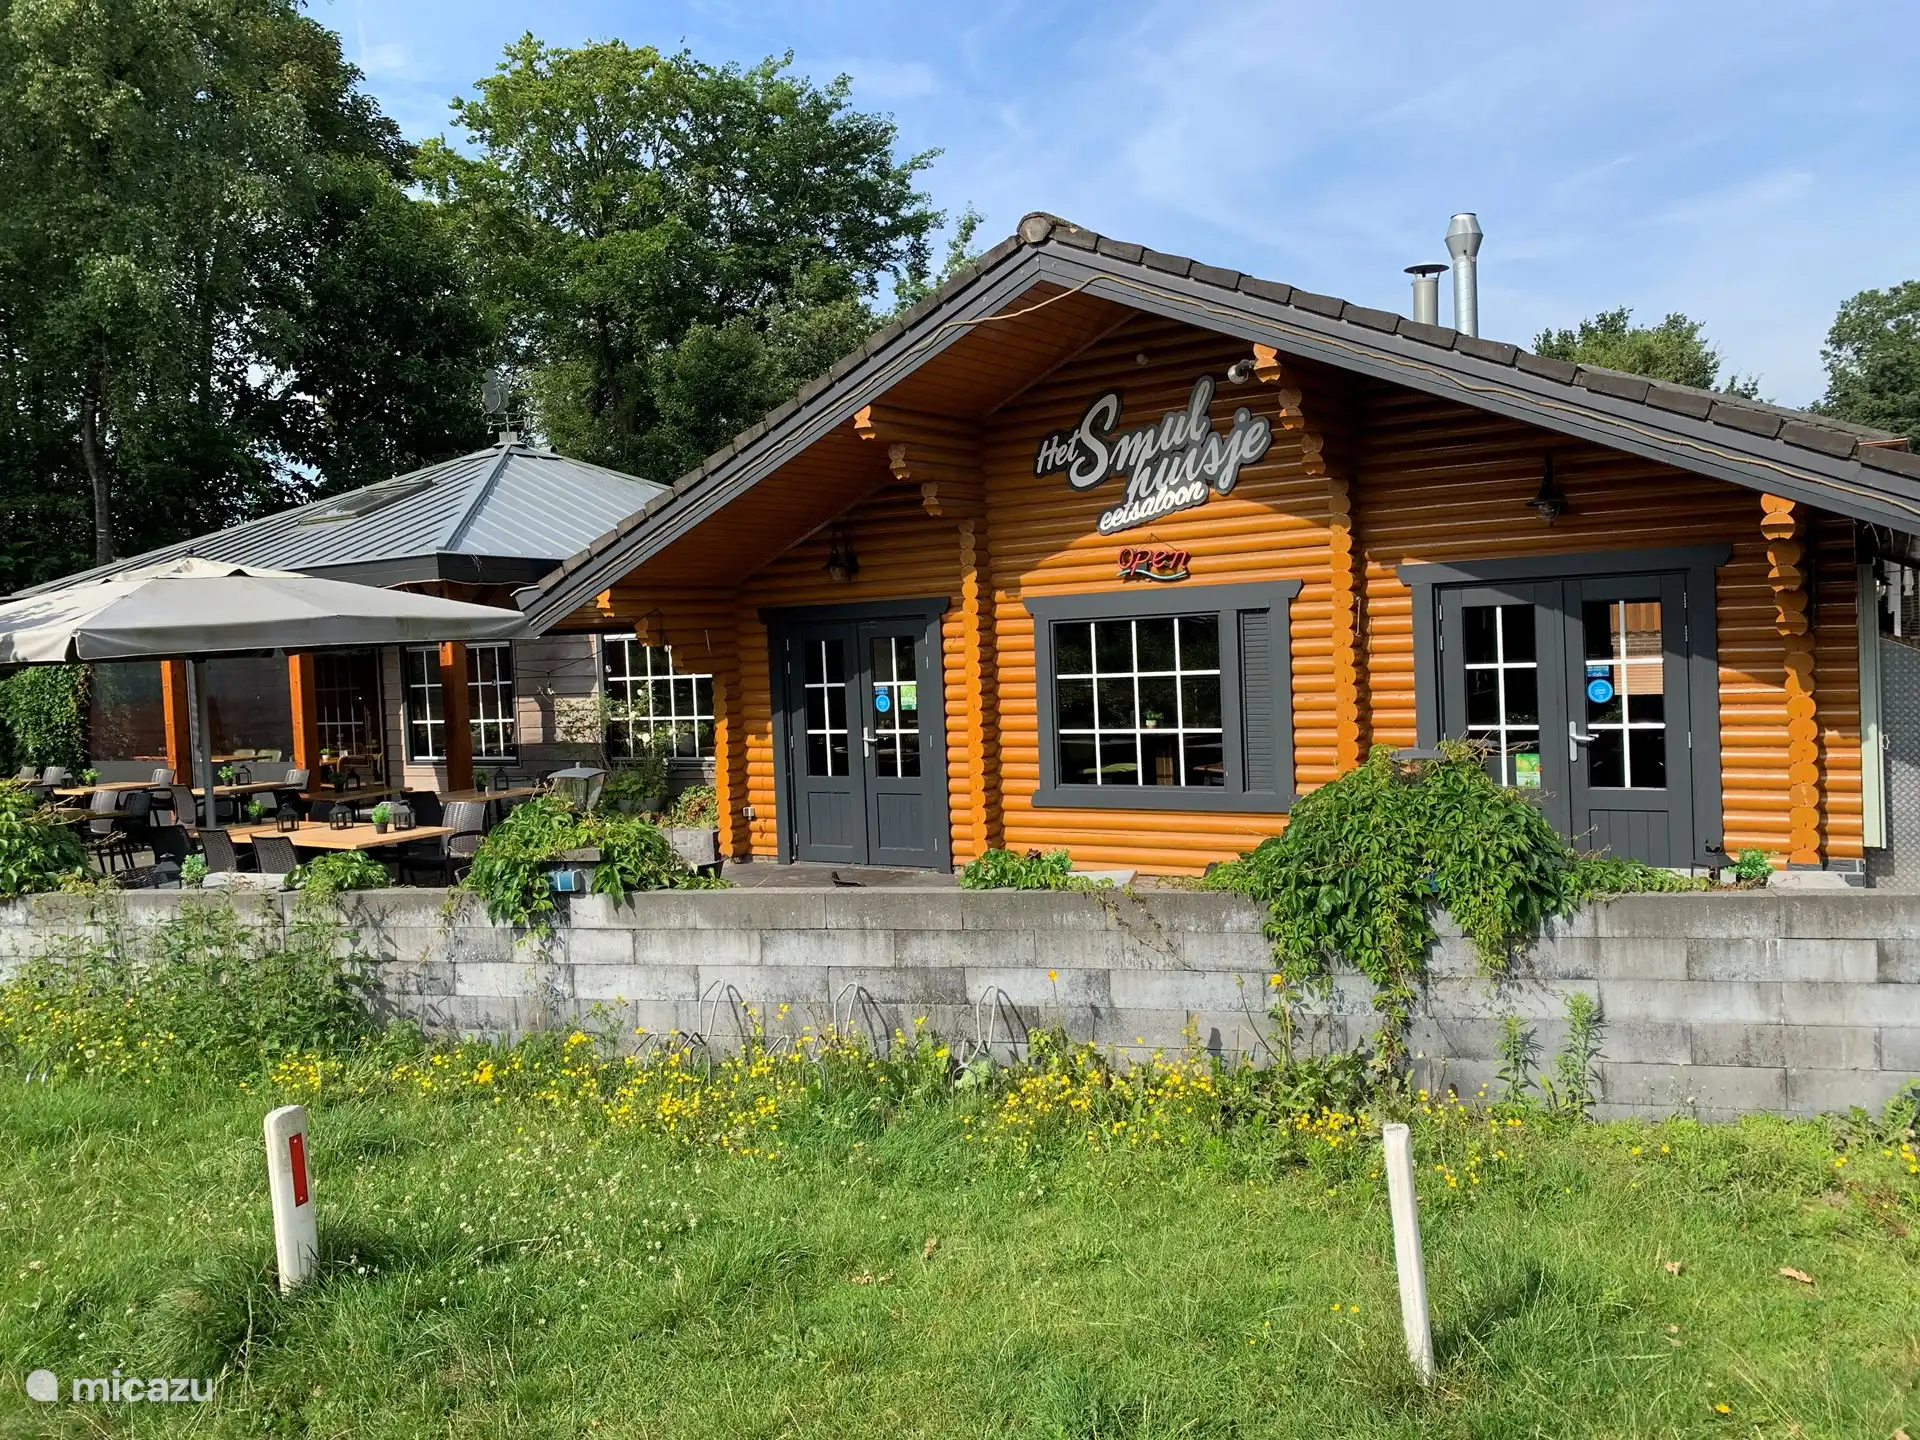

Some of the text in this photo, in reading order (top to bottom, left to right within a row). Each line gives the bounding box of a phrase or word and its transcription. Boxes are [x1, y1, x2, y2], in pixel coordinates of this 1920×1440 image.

[1037, 380, 1210, 487] Het Smul
[1125, 413, 1267, 500] huisje
[1100, 481, 1204, 530] eetsaloon
